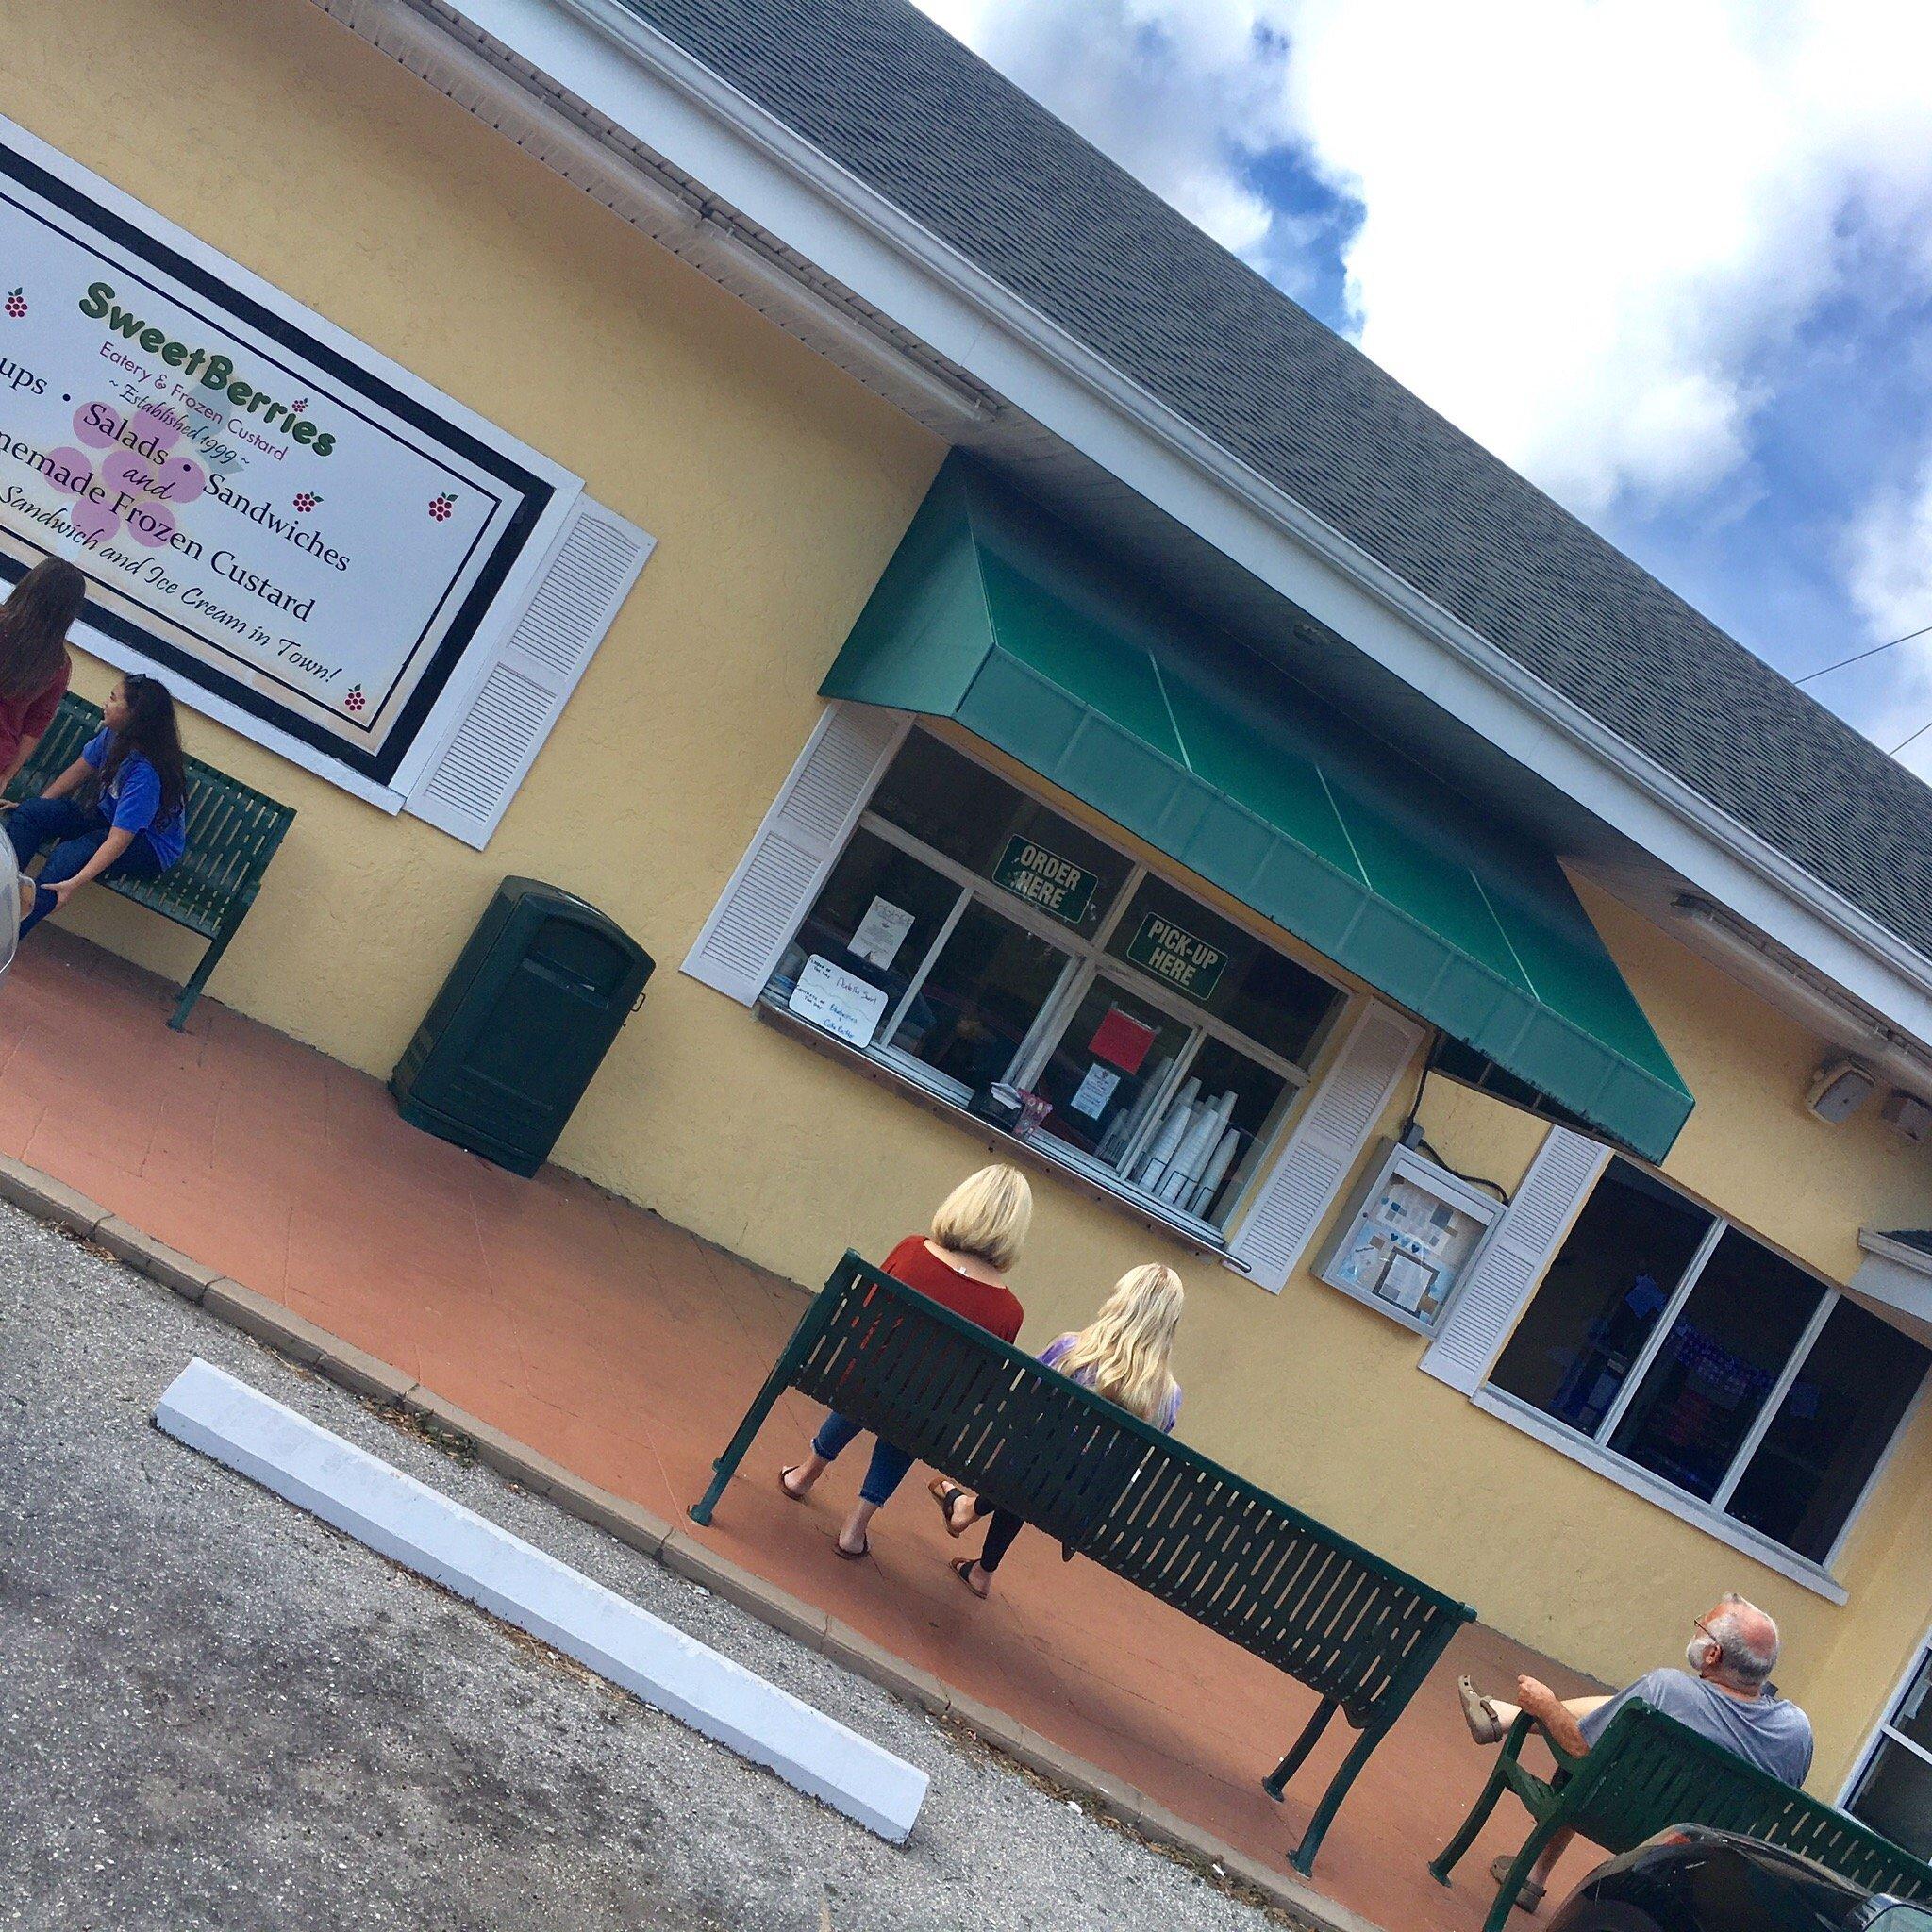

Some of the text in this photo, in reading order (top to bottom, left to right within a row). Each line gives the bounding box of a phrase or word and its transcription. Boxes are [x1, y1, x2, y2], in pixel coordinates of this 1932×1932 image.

[79, 282, 337, 457] SweetBerries
[99, 341, 289, 461] Eatery & Frozen Custard
[119, 384, 237, 465] Established 1999
[83, 403, 169, 465] Salads
[203, 473, 351, 572] Sandwiches
[123, 468, 176, 500] and
[0, 485, 343, 683] Sandwich and Ice Cream in Town!
[109, 491, 204, 561] Frozen
[210, 550, 316, 623] Custard
[1016, 870, 1066, 909] HERE
[1020, 844, 1081, 891] ORDER
[1147, 919, 1219, 969] PICK-UP
[1149, 946, 1197, 986] HERE
